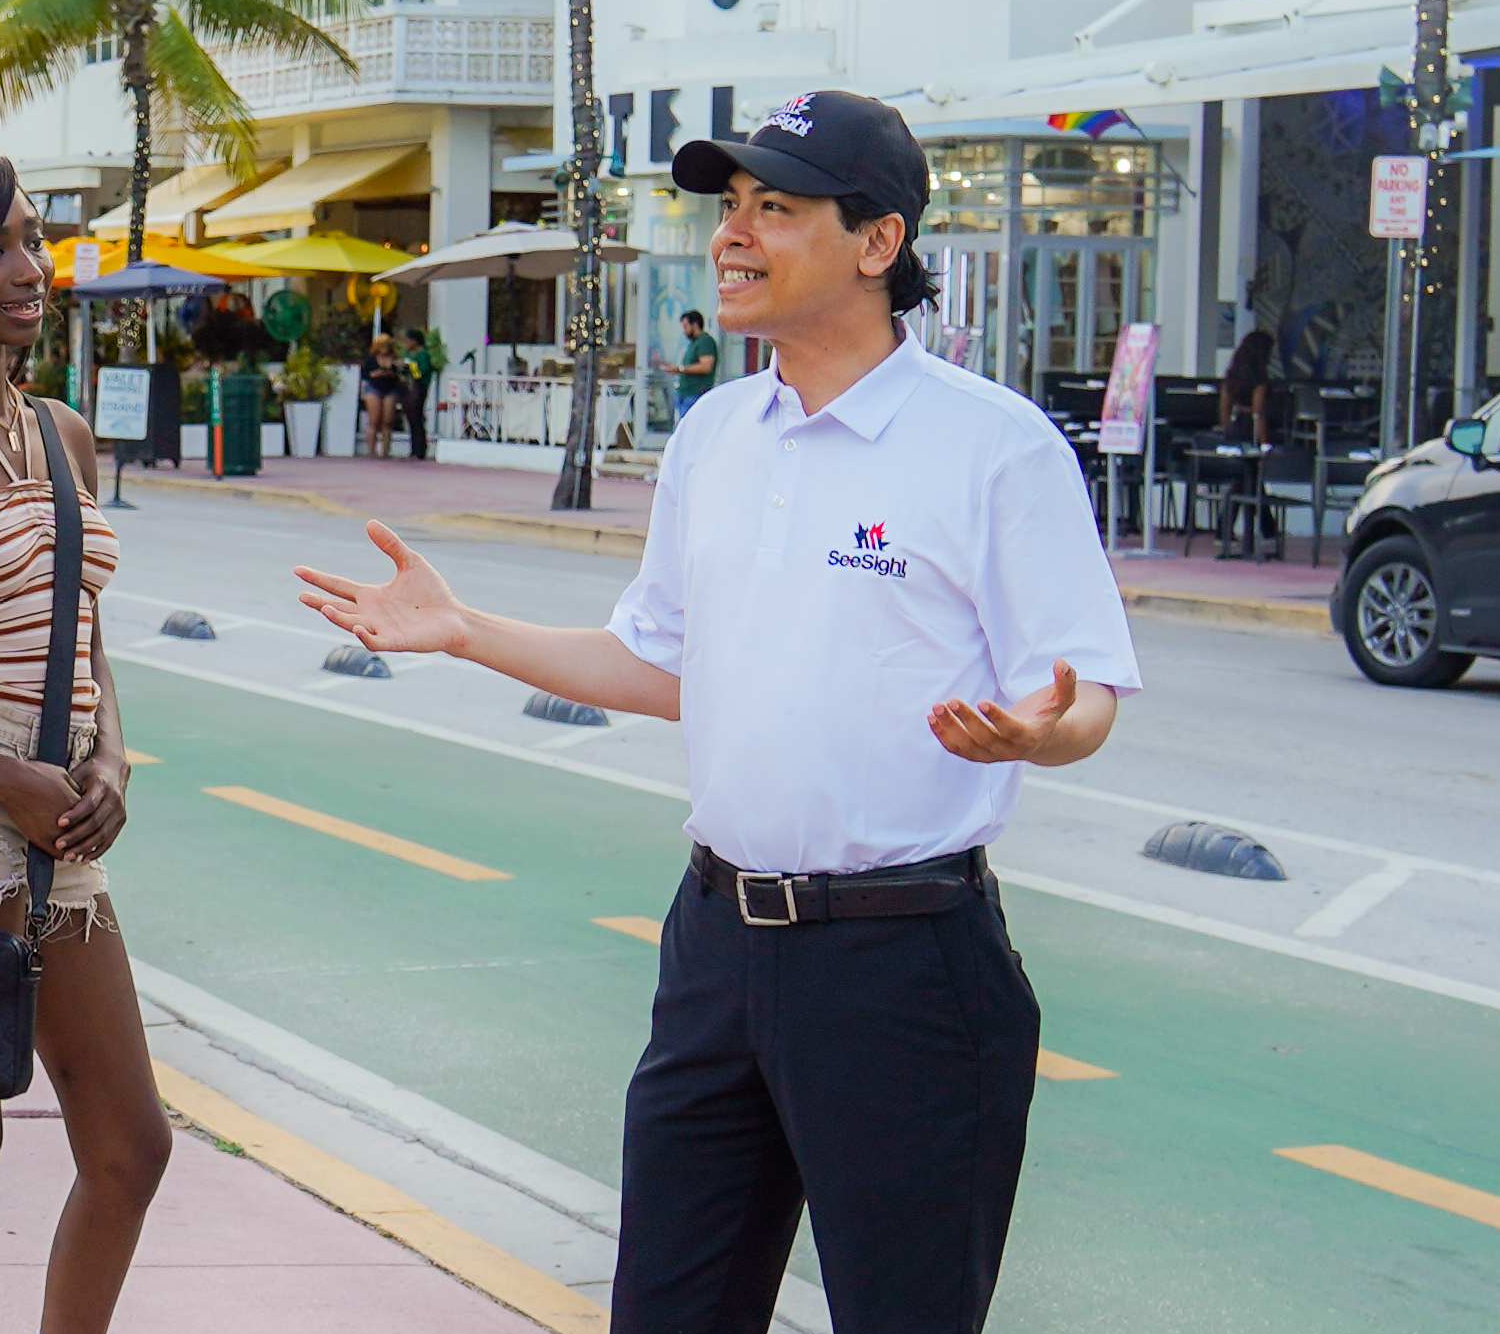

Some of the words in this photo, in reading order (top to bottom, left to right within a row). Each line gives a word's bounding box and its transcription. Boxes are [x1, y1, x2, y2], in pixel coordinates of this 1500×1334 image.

[608, 86, 749, 170] TEL
[1390, 163, 1408, 177] NO
[828, 550, 907, 575] SeeSight
